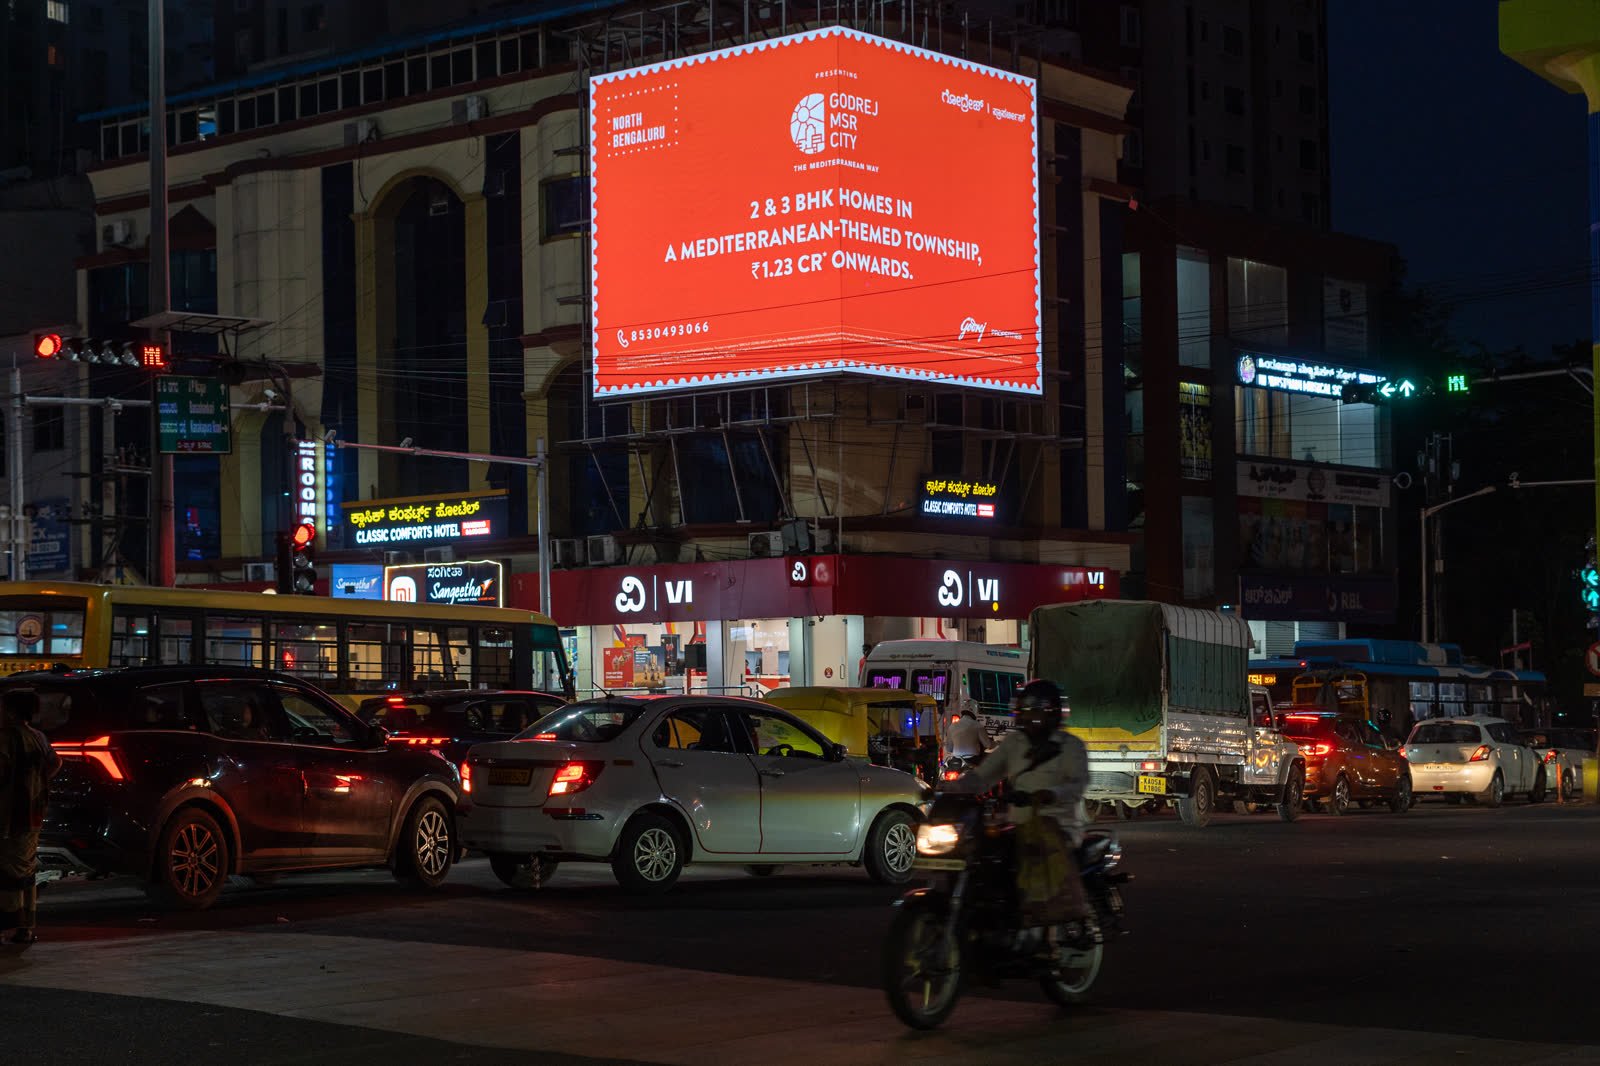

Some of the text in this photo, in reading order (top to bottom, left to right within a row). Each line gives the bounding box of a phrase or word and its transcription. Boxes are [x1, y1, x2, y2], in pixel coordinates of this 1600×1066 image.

[816, 69, 858, 79] PRESENTING
[830, 92, 878, 116] GODREJ
[612, 112, 642, 130] NORTH
[830, 112, 858, 130] MSR
[613, 126, 666, 148] BENGALURU
[830, 132, 857, 150] CITY
[794, 158, 880, 172] THE MEDITERRANEAN WAY
[750, 187, 913, 220] 2 & 3 BHK HOMES IN
[664, 218, 982, 266] A MEDITERRANEAN-THEMED TOWNSHIP,
[751, 258, 793, 280] ₹1.23
[831, 251, 914, 281] ONWARDS.
[630, 320, 710, 342] 8530493066
[301, 457, 316, 526] ROOMS
[350, 508, 385, 528] ಕ್ಲಾಸಿಕ್
[435, 500, 480, 518] ಹೋಟೆಲ್
[924, 500, 942, 513] CLASSIC
[942, 501, 964, 515] COMFORTS
[964, 503, 977, 516] HOTEL
[356, 527, 389, 544] CLASSIC
[390, 525, 432, 542] COMFORTS
[434, 523, 460, 538] HOTEL
[430, 578, 482, 604] Sangeetha
